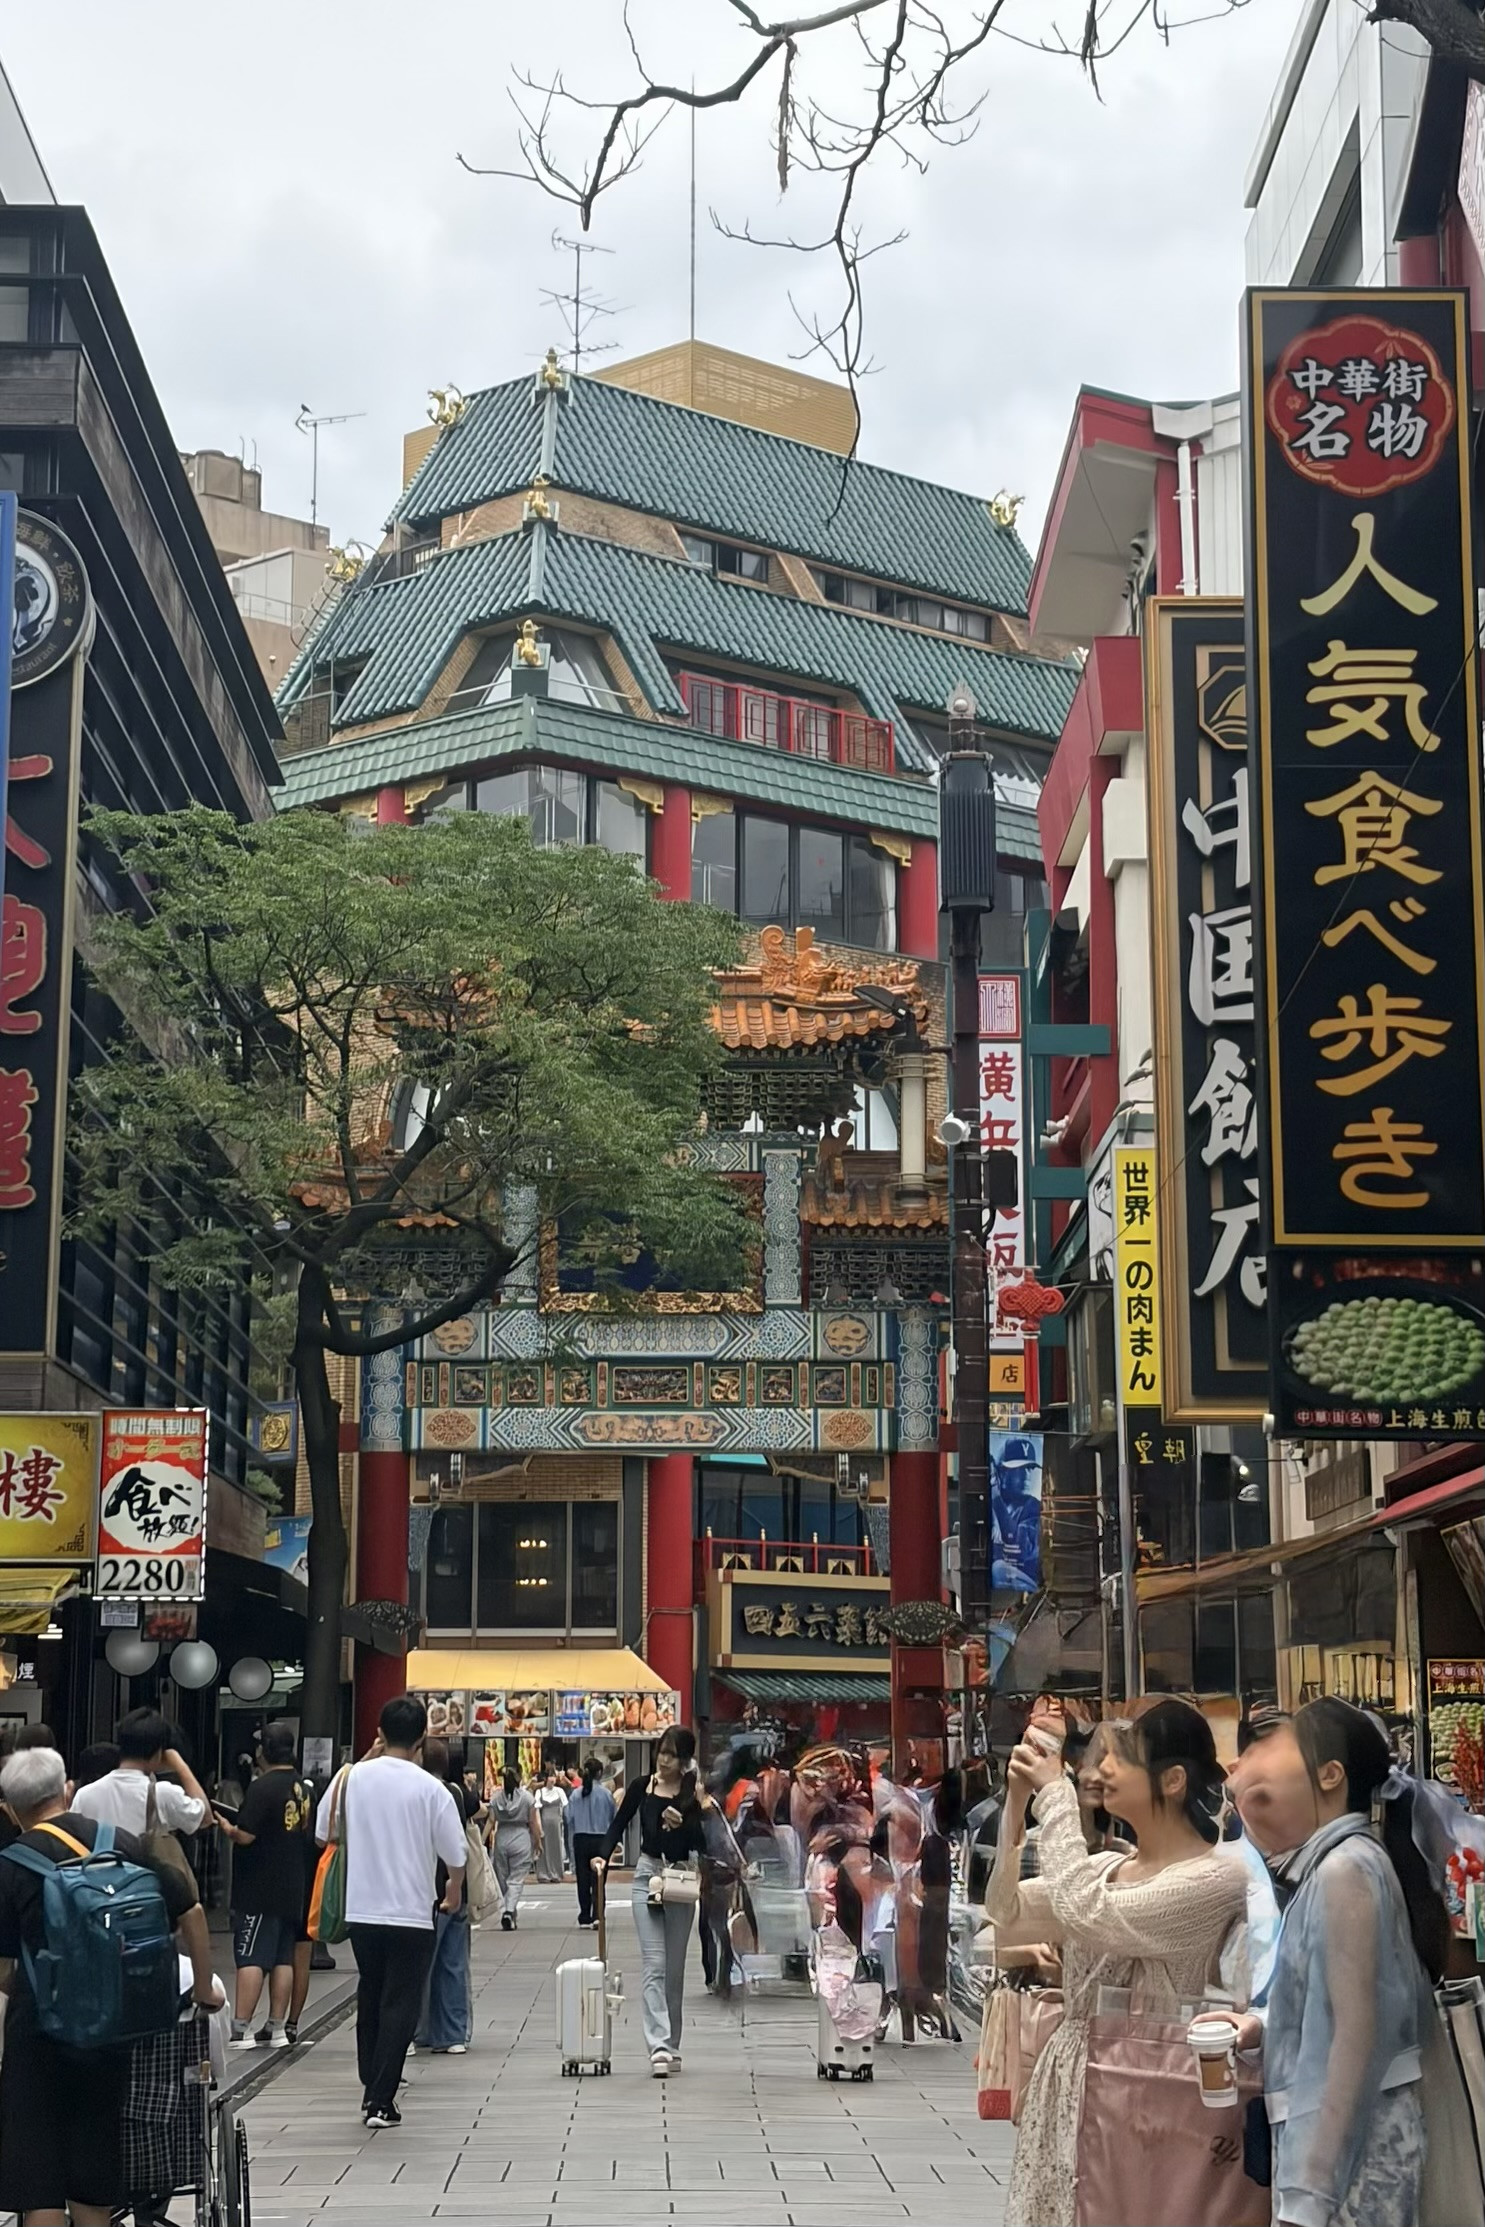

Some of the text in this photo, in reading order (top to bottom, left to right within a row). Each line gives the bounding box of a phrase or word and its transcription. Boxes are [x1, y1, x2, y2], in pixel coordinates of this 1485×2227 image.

[1290, 358, 1428, 402] 中華街
[1292, 400, 1428, 458] 名物
[1300, 512, 1453, 1208] 人気食べ歩き
[1122, 1161, 1156, 1391] 世界一の肉まん
[104, 1466, 192, 1522] 食べ
[101, 1559, 184, 1592] 2280
